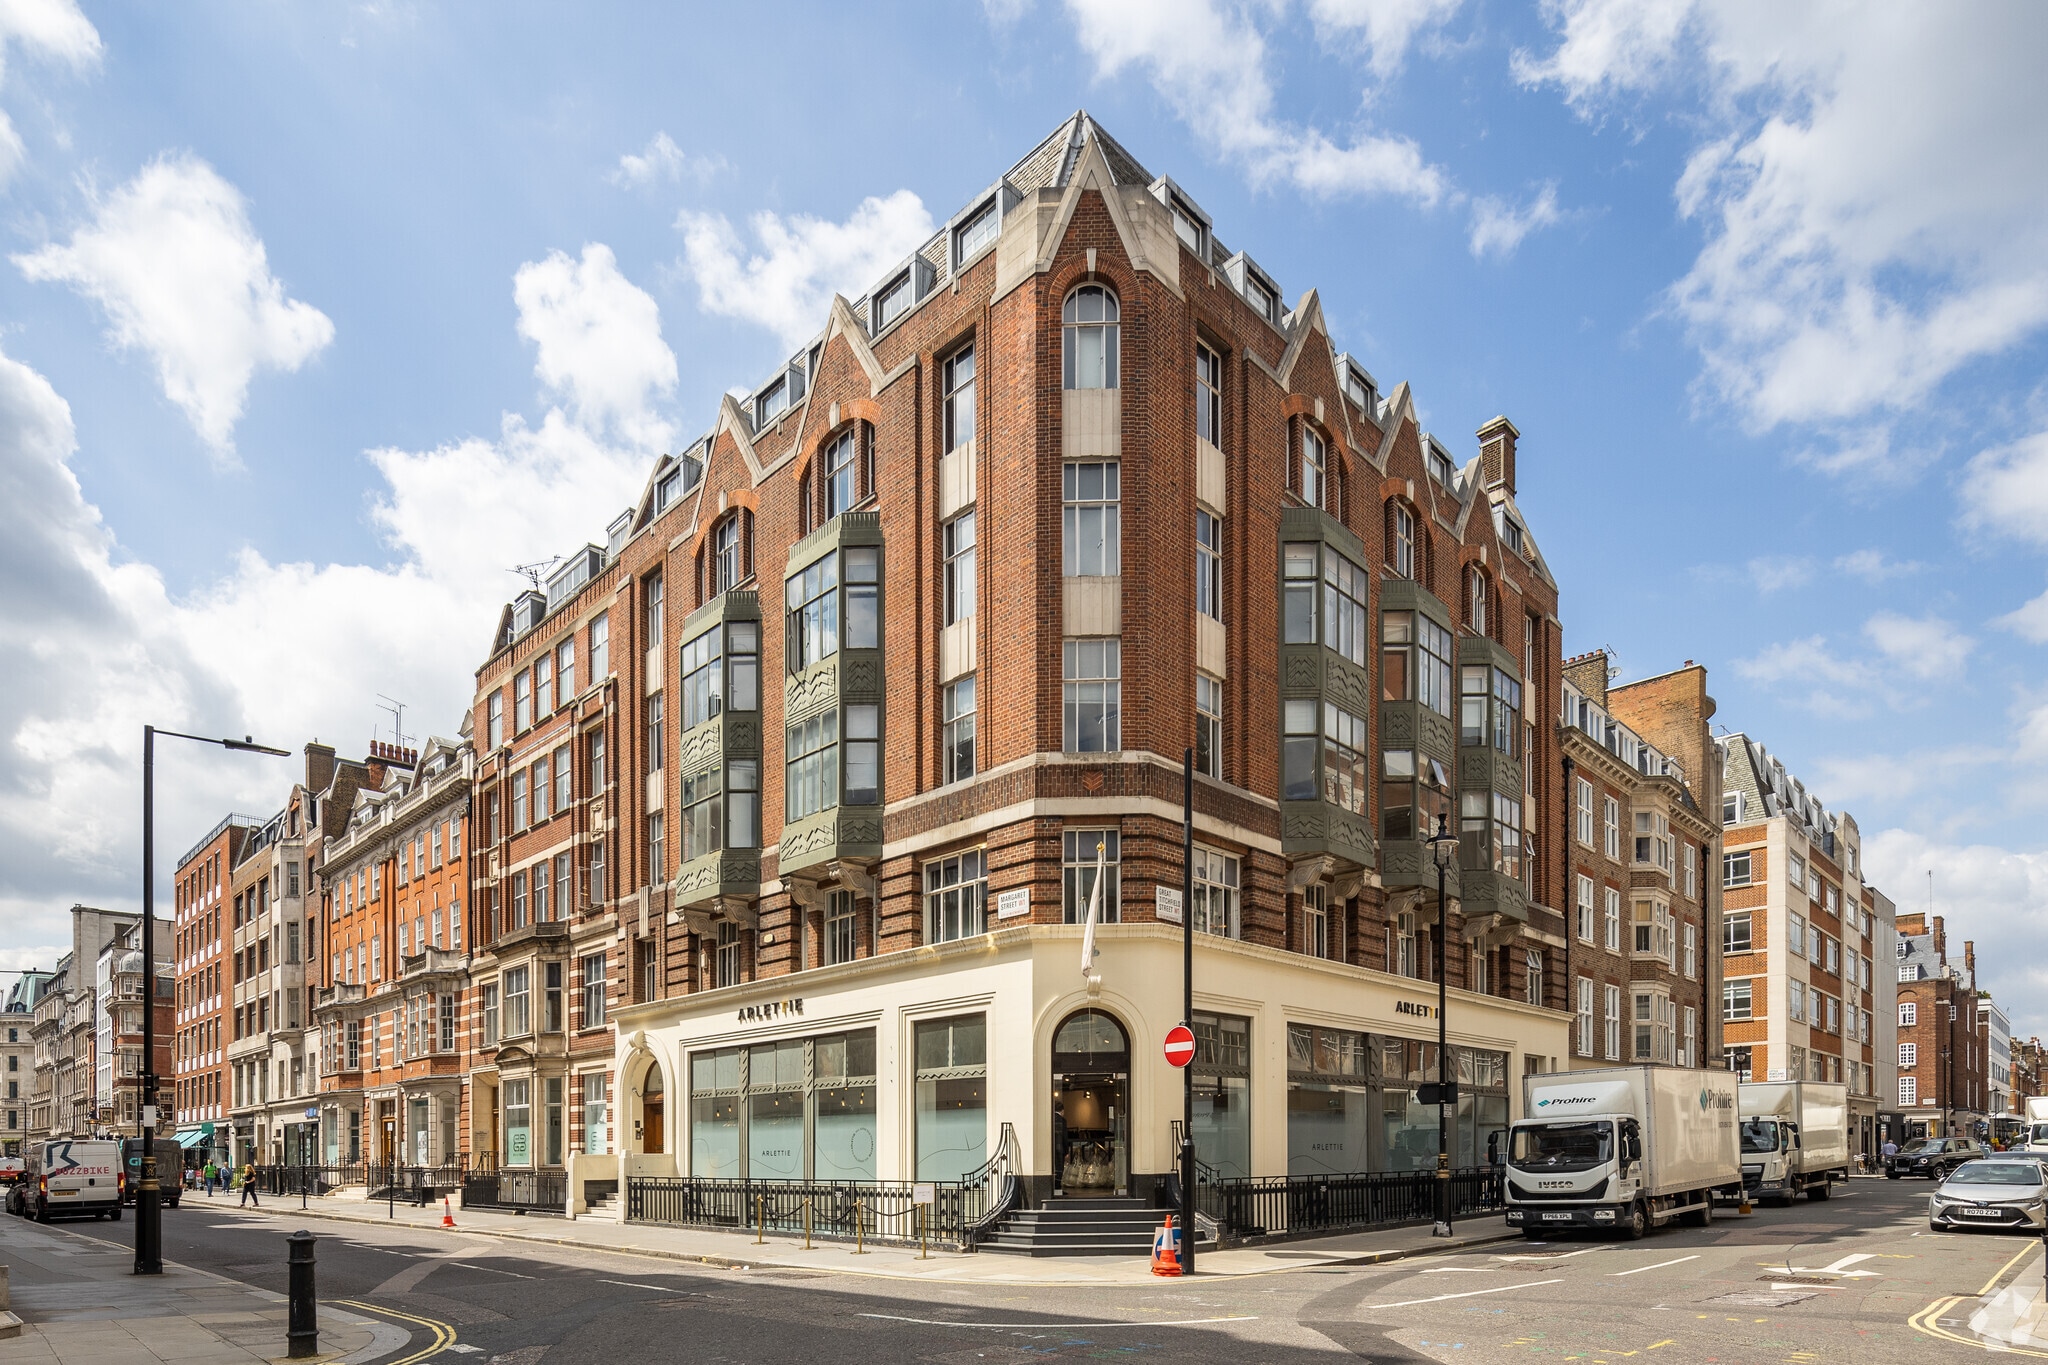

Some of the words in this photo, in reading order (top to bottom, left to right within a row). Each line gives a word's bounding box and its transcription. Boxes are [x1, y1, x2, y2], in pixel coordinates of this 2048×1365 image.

[1000, 891, 1026, 904] MARGARET
[1158, 888, 1172, 898] GREAT
[1000, 900, 1018, 911] STREET
[1158, 904, 1174, 913] STREET
[738, 998, 803, 1021] ARLETTIE
[1395, 1000, 1439, 1019] ARLETTI
[1551, 1097, 1597, 1105] Prohire
[1708, 1088, 1732, 1109] Prohire
[1312, 1143, 1343, 1151] ARLETTIE
[55, 1166, 110, 1176] BUZZBIKE
[1538, 1181, 1573, 1189] IVECO
